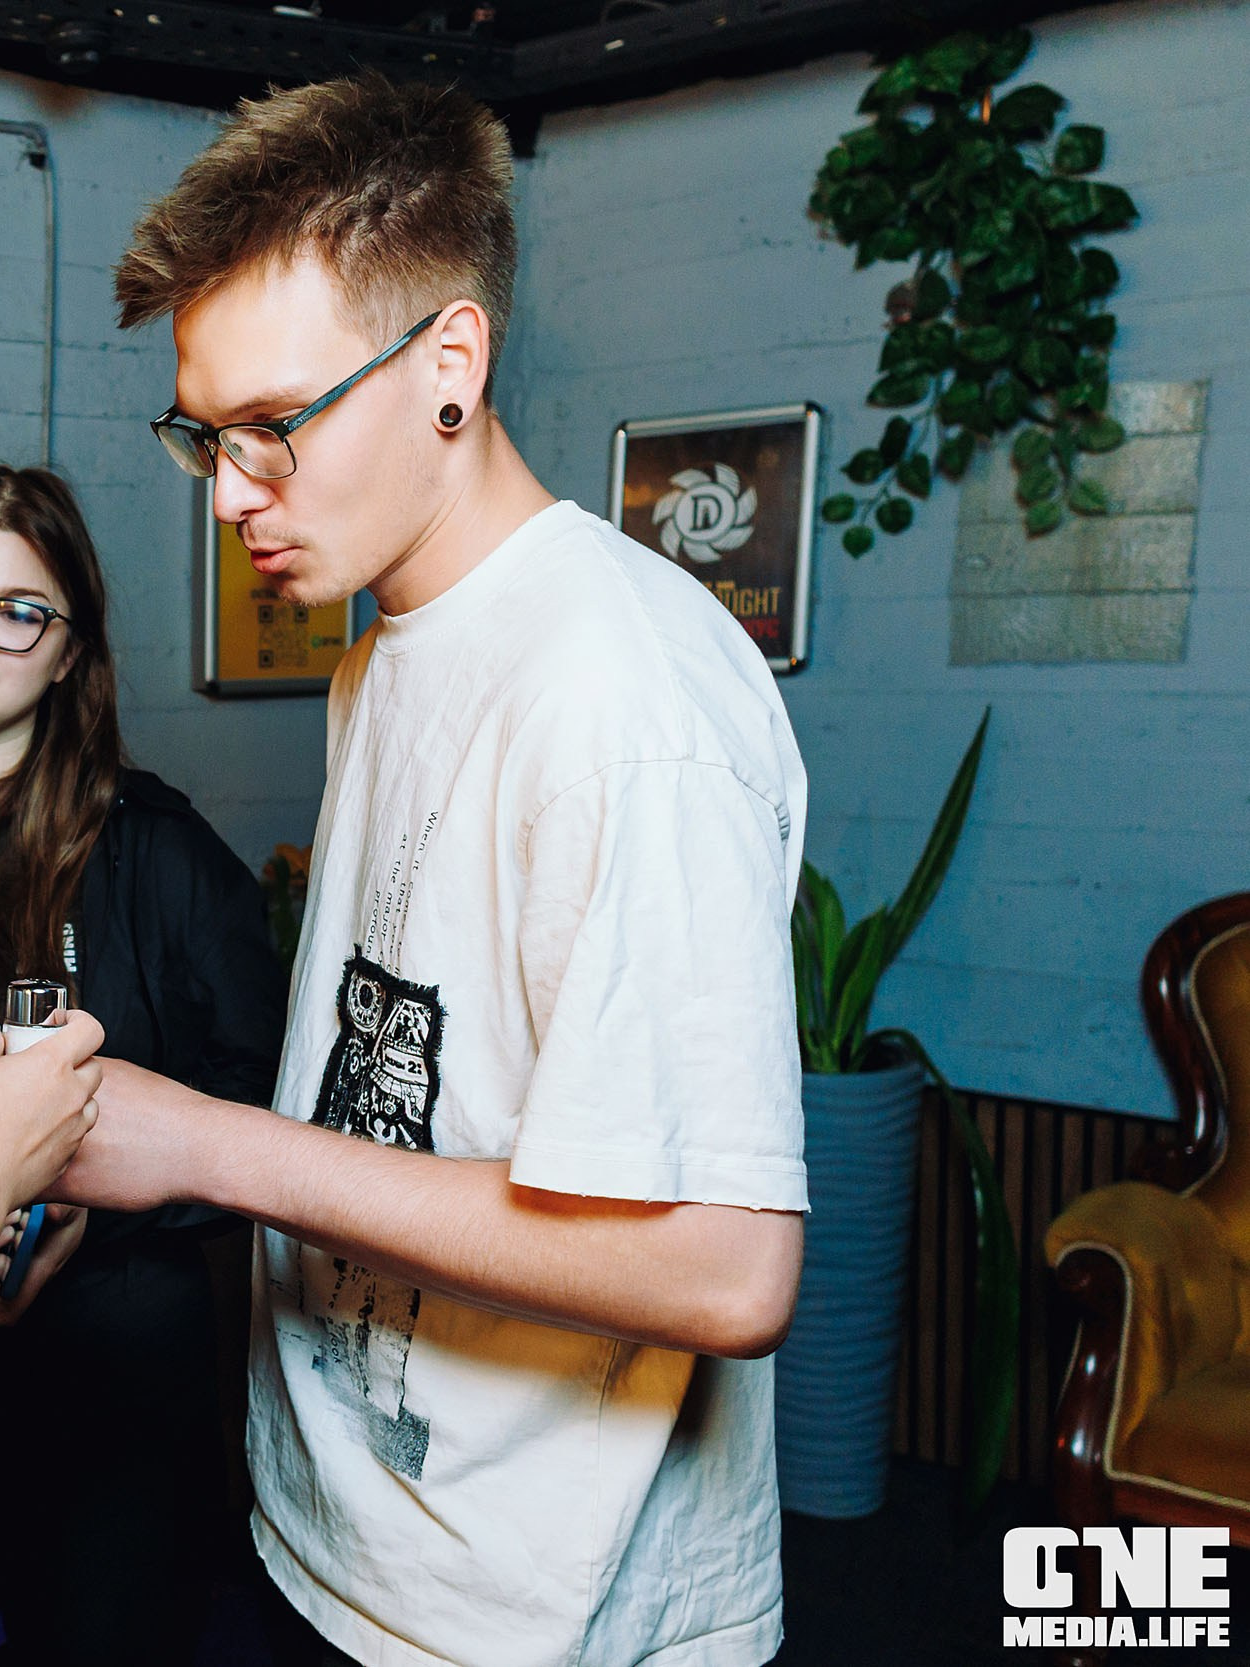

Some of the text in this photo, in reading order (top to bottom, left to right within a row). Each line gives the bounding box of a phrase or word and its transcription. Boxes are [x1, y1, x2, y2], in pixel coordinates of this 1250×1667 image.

[400, 834, 408, 850] at
[418, 811, 439, 851] When
[390, 860, 401, 884] the
[412, 860, 420, 871] it
[381, 892, 393, 942] major
[329, 1275, 347, 1309] have
[330, 1332, 343, 1364] look
